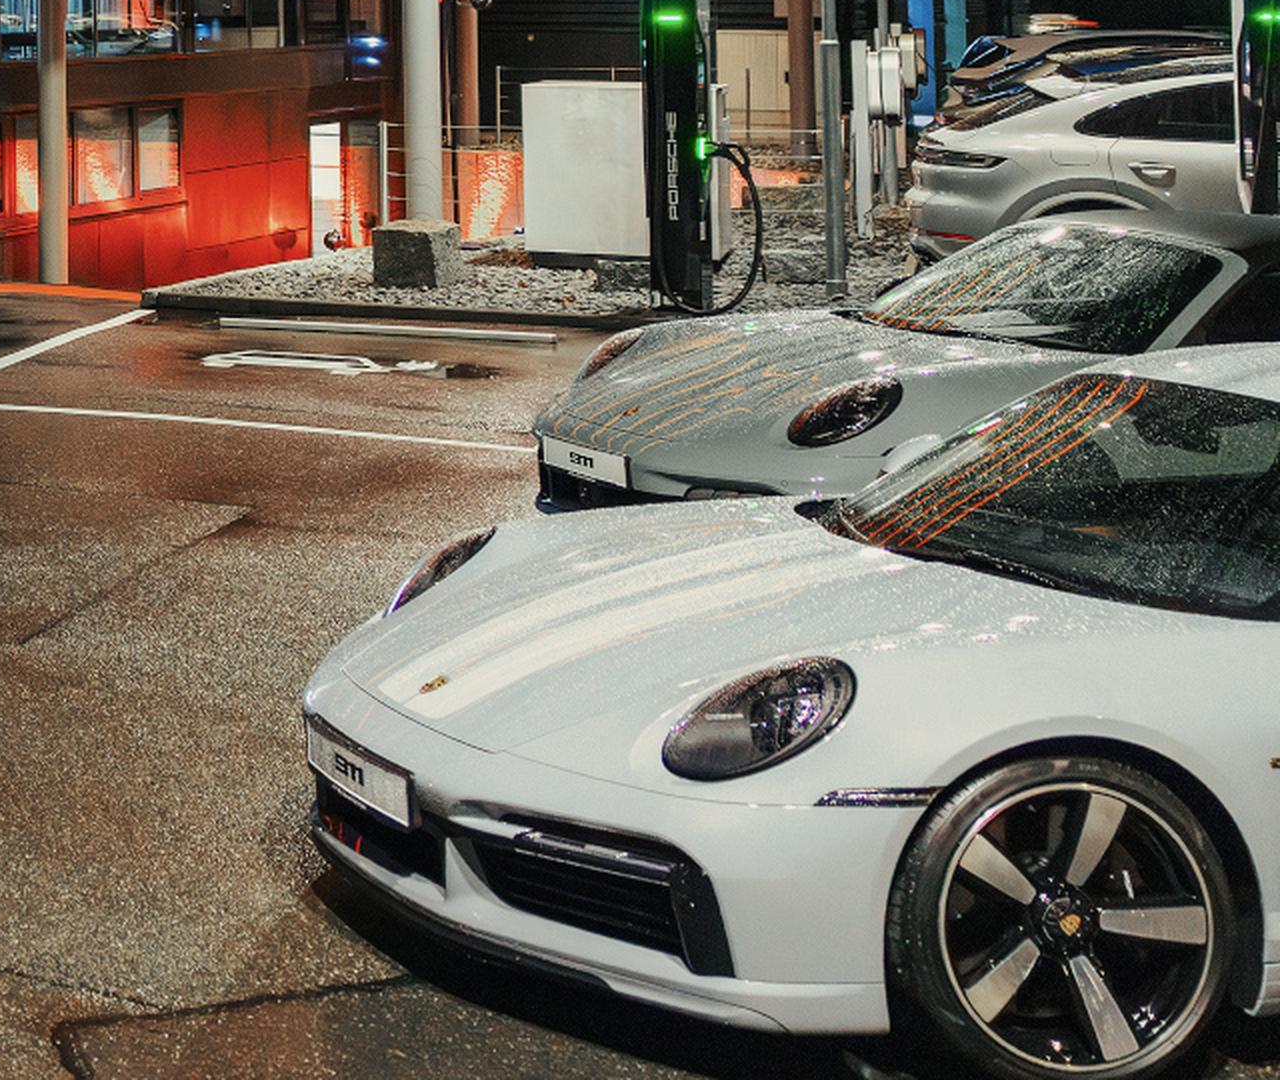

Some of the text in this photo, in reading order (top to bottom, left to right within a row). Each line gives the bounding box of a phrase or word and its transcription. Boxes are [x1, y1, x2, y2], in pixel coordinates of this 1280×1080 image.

[665, 111, 680, 220] PORSCHE
[569, 452, 594, 469] 911
[335, 753, 365, 787] 911
